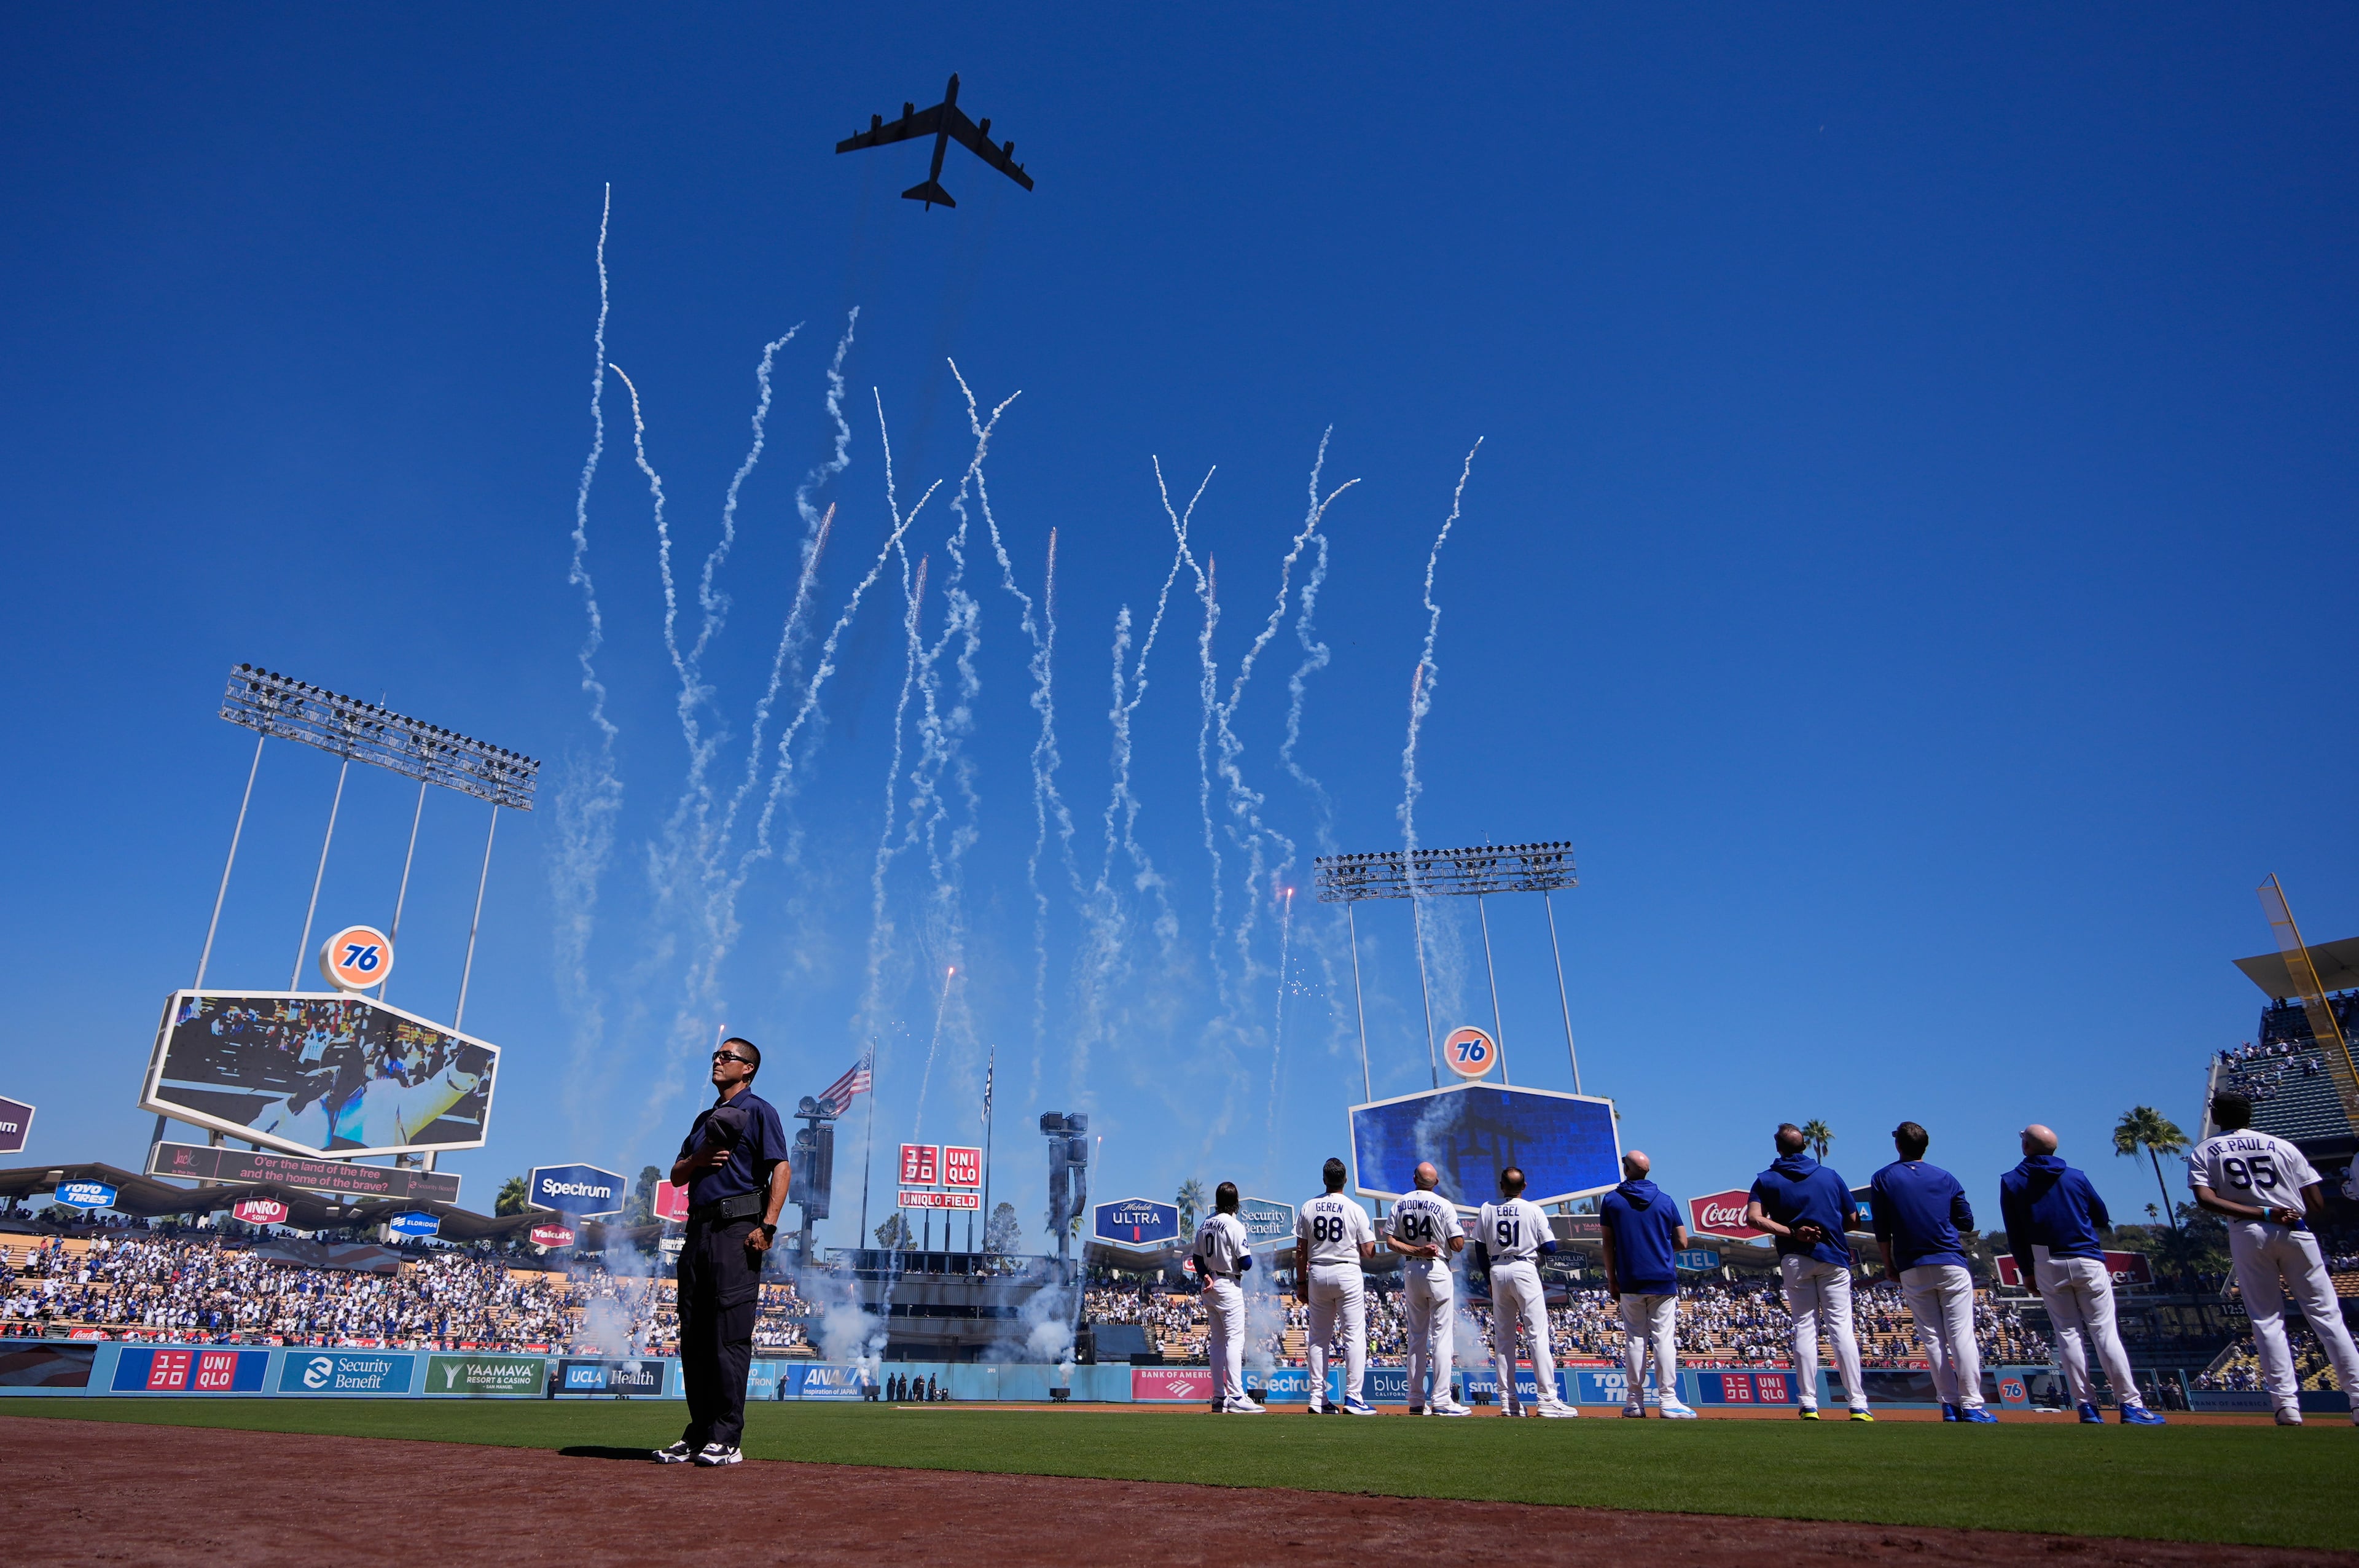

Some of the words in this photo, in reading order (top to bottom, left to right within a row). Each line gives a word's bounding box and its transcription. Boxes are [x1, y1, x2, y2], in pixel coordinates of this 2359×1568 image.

[340, 943, 381, 972] 76
[1455, 1038, 1486, 1063] 76
[2207, 1142, 2228, 1156] DE
[2228, 1139, 2275, 1152] PAULA
[173, 1149, 200, 1167] Jack
[949, 1152, 973, 1166] UNI
[255, 1156, 278, 1166] O'er
[281, 1158, 299, 1169] the
[301, 1161, 324, 1173] land
[327, 1165, 339, 1174] of
[340, 1166, 358, 1176] the
[360, 1168, 380, 1179] free
[2223, 1155, 2277, 1190] 95
[240, 1169, 263, 1179] and
[265, 1171, 284, 1181] the
[286, 1172, 316, 1184] home
[319, 1175, 332, 1185] of
[334, 1177, 351, 1188] the
[353, 1180, 388, 1192] brave?
[949, 1168, 976, 1183] QLO
[418, 1182, 437, 1192] Security
[541, 1178, 611, 1198] Spectrum
[68, 1193, 108, 1204] TIRES
[903, 1194, 941, 1207] UNIQLO
[944, 1196, 976, 1207] FIELD
[241, 1200, 281, 1216] JINRO
[1120, 1202, 1152, 1212] Michelob
[1316, 1202, 1344, 1214] GEREN
[1496, 1206, 1519, 1217] EBEL
[1113, 1213, 1160, 1224] ULTRA
[1241, 1209, 1286, 1223] Security
[533, 1229, 573, 1239] Yakult
[1313, 1215, 1343, 1242] 88
[1402, 1214, 1433, 1242] 84
[1496, 1220, 1519, 1247] 91
[1205, 1233, 1215, 1258] 0
[1679, 1253, 1715, 1266] TEL
[2221, 1305, 2243, 1314] 12:5
[203, 1356, 232, 1370] UNI
[338, 1357, 393, 1376] Security
[200, 1372, 230, 1387] QLO
[334, 1374, 382, 1389] Benefit
[571, 1370, 602, 1383] UCLA
[610, 1370, 654, 1386] Health
[804, 1368, 840, 1386] ANA
[1246, 1376, 1310, 1392] Spectru
[1374, 1375, 1409, 1392] blue
[1759, 1378, 1780, 1387] UNI
[1604, 1388, 1659, 1402] TIES
[1762, 1390, 1785, 1401] QLO
[2003, 1383, 2022, 1398] 76
